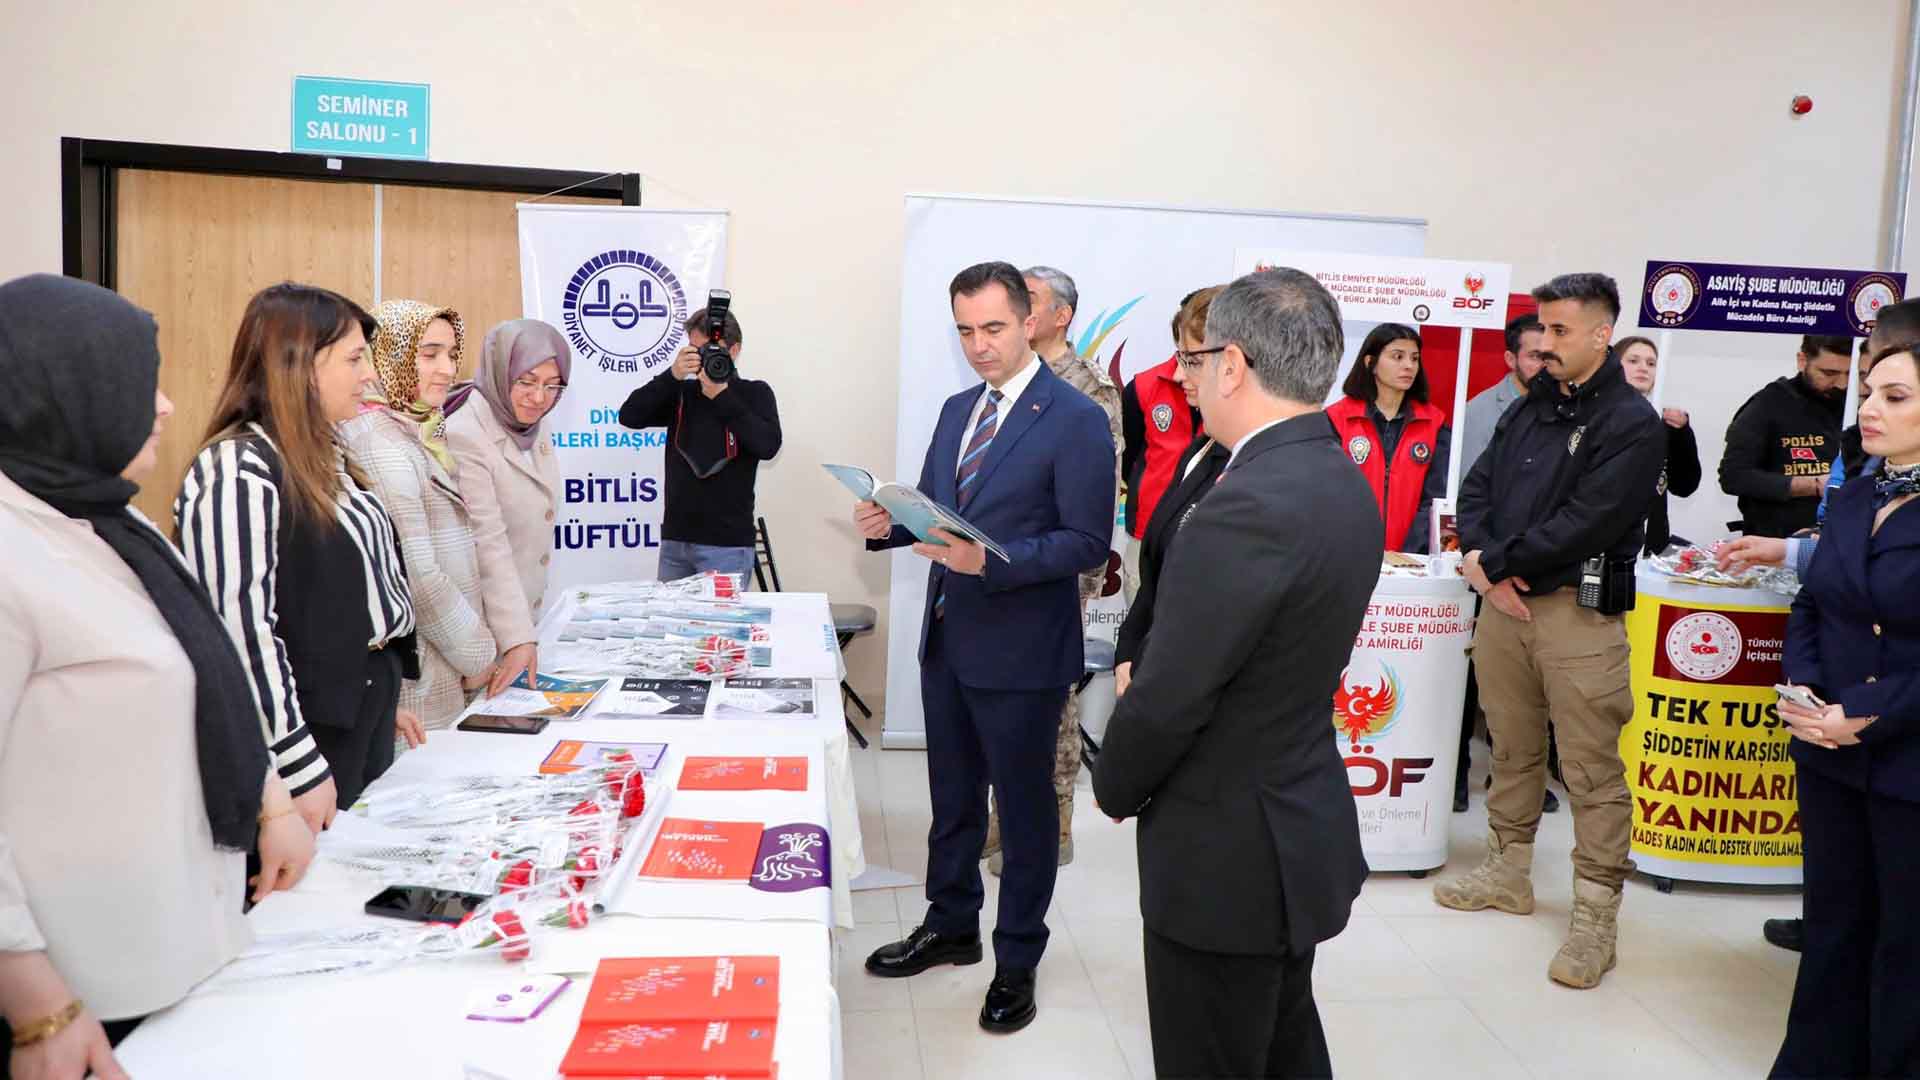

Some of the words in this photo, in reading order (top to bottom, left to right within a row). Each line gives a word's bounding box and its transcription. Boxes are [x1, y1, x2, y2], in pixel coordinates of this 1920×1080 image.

[317, 94, 409, 118] SEMİNER
[306, 120, 385, 143] SALONU
[408, 127, 417, 145] 1
[1342, 274, 1376, 283] EMNİYET
[1706, 274, 1746, 295] ASAYİŞ
[1747, 277, 1777, 295] ŞUBE
[1779, 277, 1845, 296] MÜDÜRLÜĞÜ
[1331, 283, 1373, 294] MÜCADELE
[1375, 286, 1396, 295] ŞUBE
[1711, 297, 1728, 306] Aile
[1727, 311, 1765, 322] Mücadele
[563, 312, 598, 360] DİYANET
[598, 353, 639, 373] İŞLERİ
[1784, 461, 1830, 476] BİTLİS
[565, 472, 658, 503] BİTLİS
[1384, 603, 1460, 619] MÜDÜRLÜĞÜ
[1380, 622, 1414, 635] ŞUBE
[1367, 636, 1424, 650] AMİRLİĞİ
[1647, 692, 1710, 725] TEK
[1642, 728, 1721, 760] ŞİDDETİN
[1632, 826, 1663, 848] KADES
[1665, 834, 1696, 854] KADIN
[1698, 835, 1718, 855] ACİL
[1720, 840, 1752, 856] DESTEK
